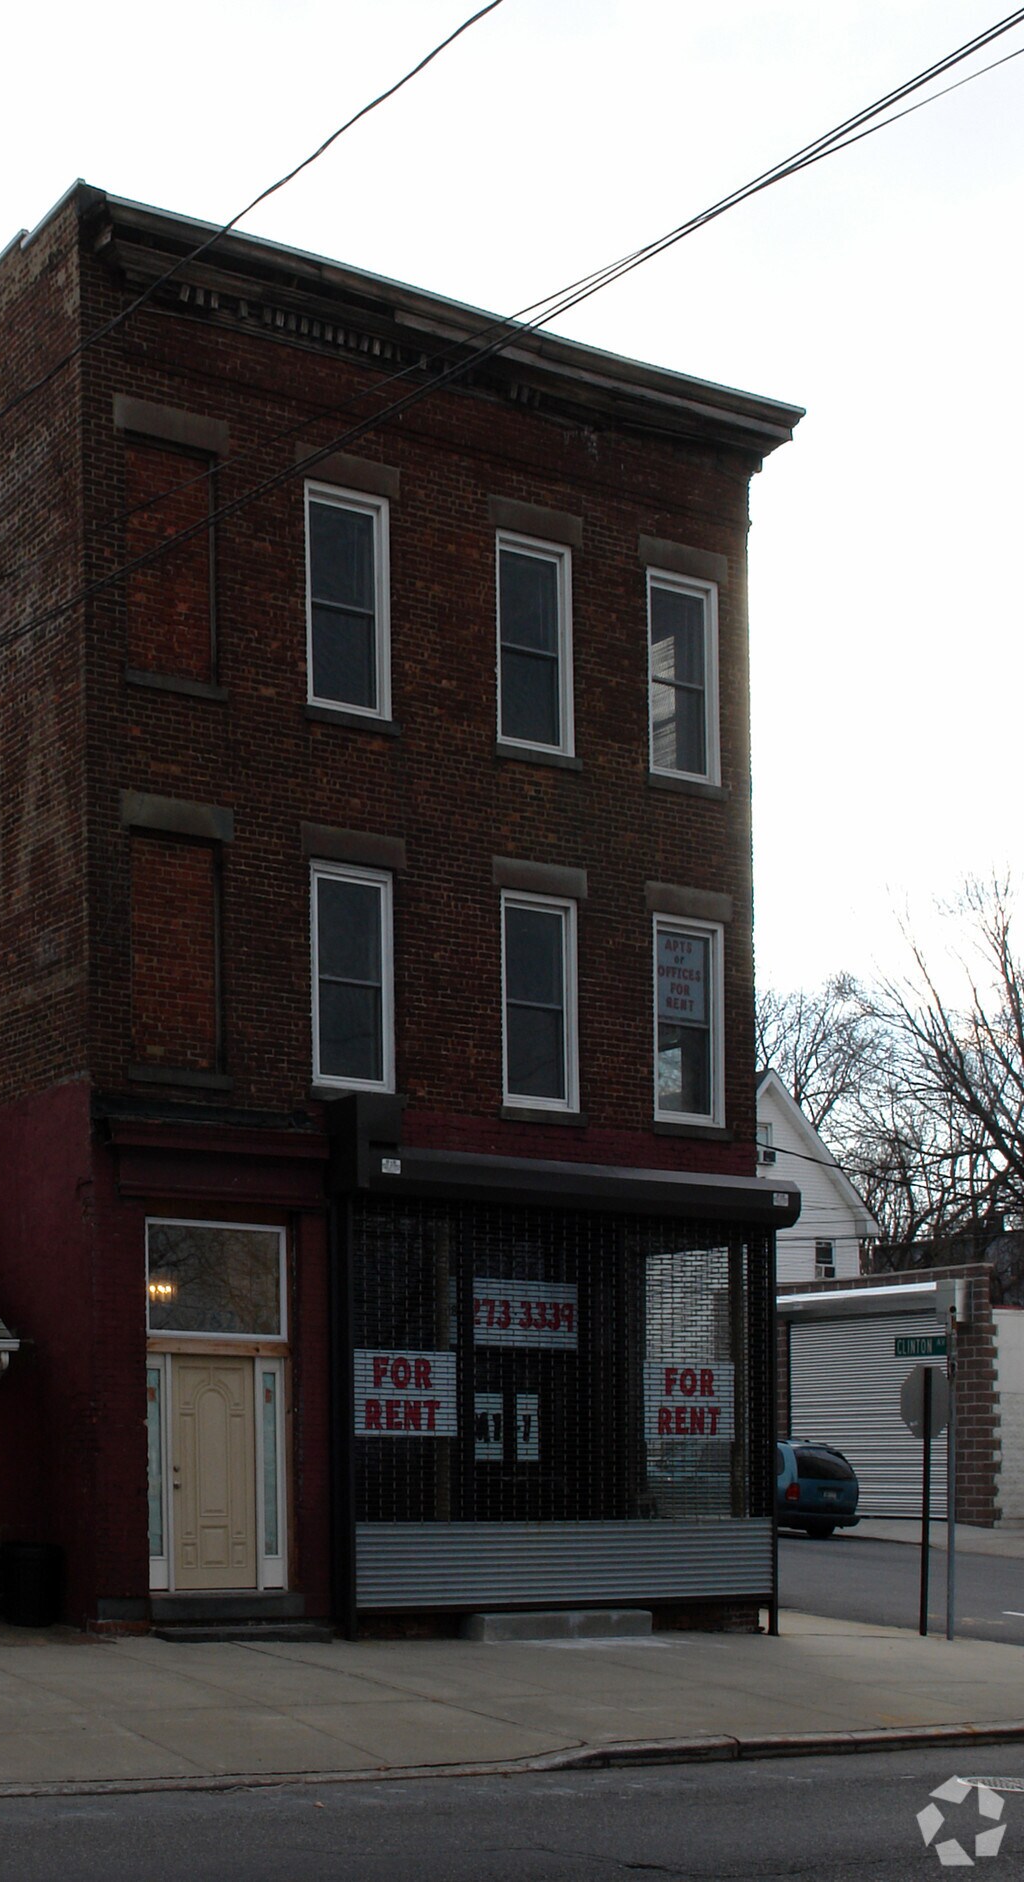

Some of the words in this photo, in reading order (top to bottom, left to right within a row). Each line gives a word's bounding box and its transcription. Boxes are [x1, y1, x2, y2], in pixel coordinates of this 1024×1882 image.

[665, 939, 692, 953] APTS
[674, 956, 684, 964] or
[658, 965, 700, 982] OFFICES
[670, 982, 690, 996] FOR
[666, 997, 695, 1012] RENT
[896, 1338, 933, 1355] CLINTON
[373, 1356, 432, 1389] FOR
[665, 1368, 714, 1396] FOR
[365, 1399, 441, 1430] RENT
[658, 1406, 721, 1435] RENT
